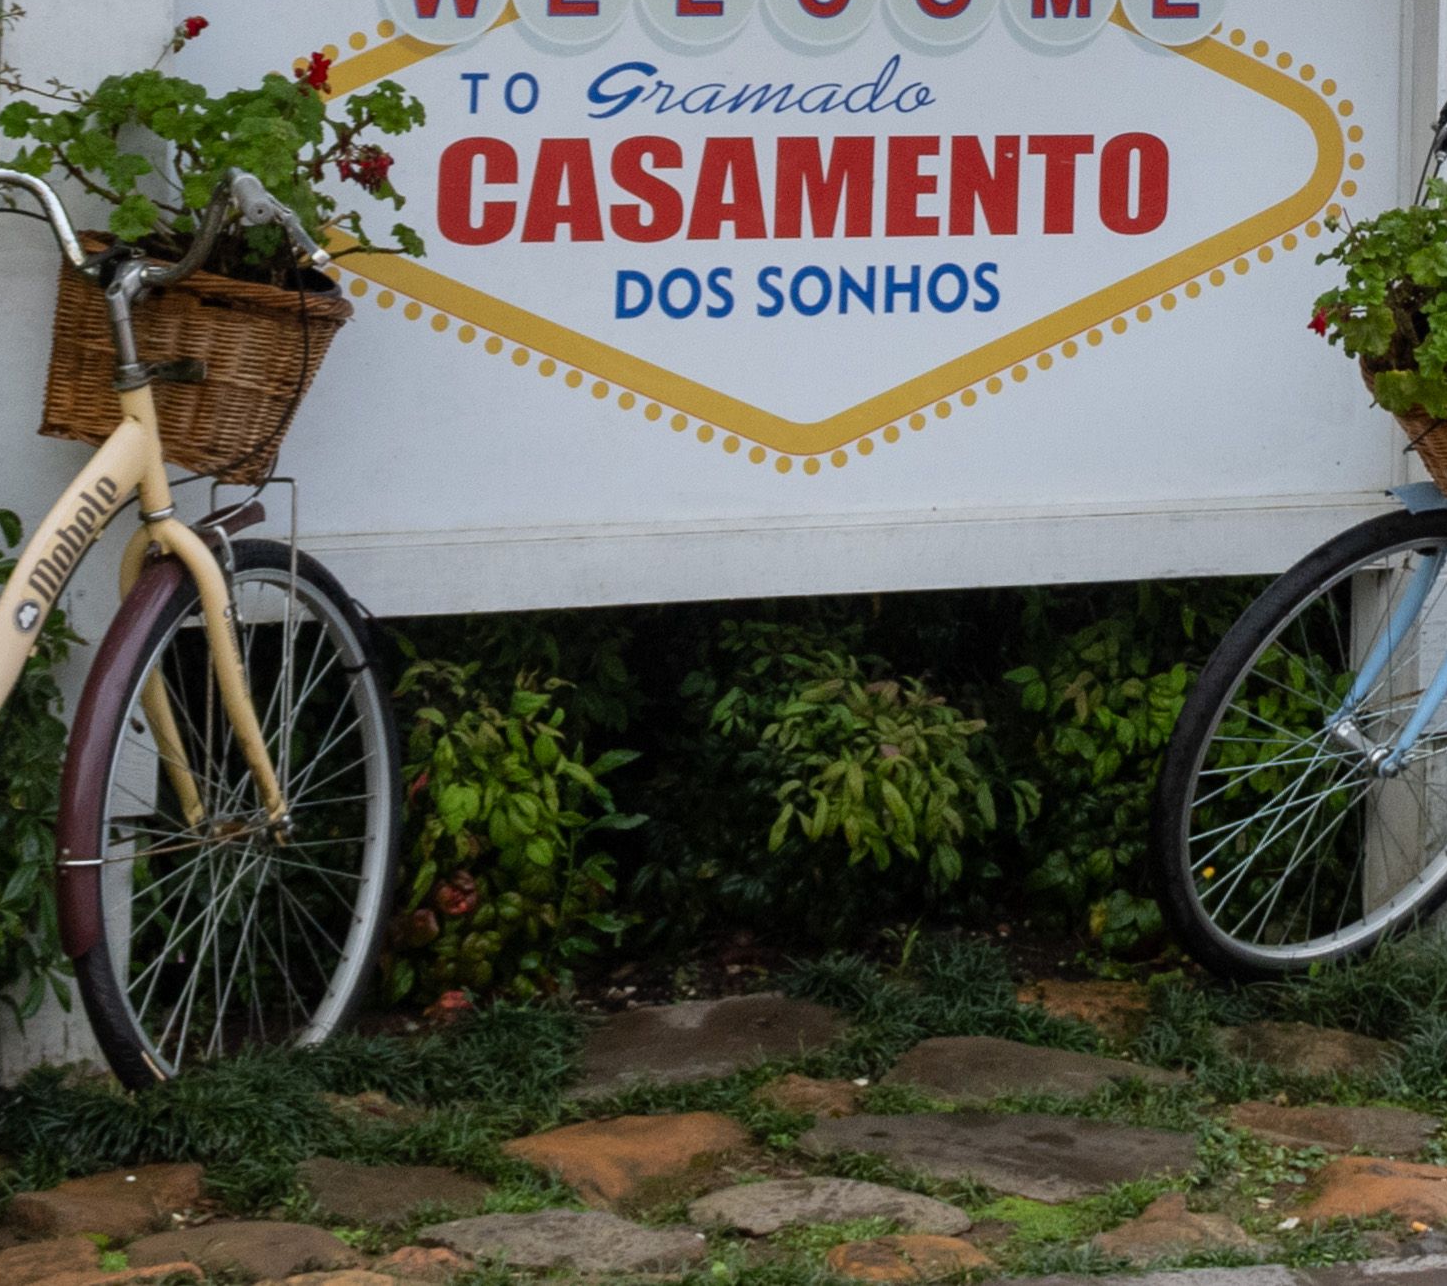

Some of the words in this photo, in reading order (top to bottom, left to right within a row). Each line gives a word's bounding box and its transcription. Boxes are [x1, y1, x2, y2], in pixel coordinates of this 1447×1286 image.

[461, 72, 539, 115] TO
[587, 54, 937, 119] Gramado
[436, 132, 1170, 245] CASAMENTO
[615, 266, 735, 320] DOS
[756, 262, 1001, 318] SONHOS
[28, 475, 118, 603] Mobele
